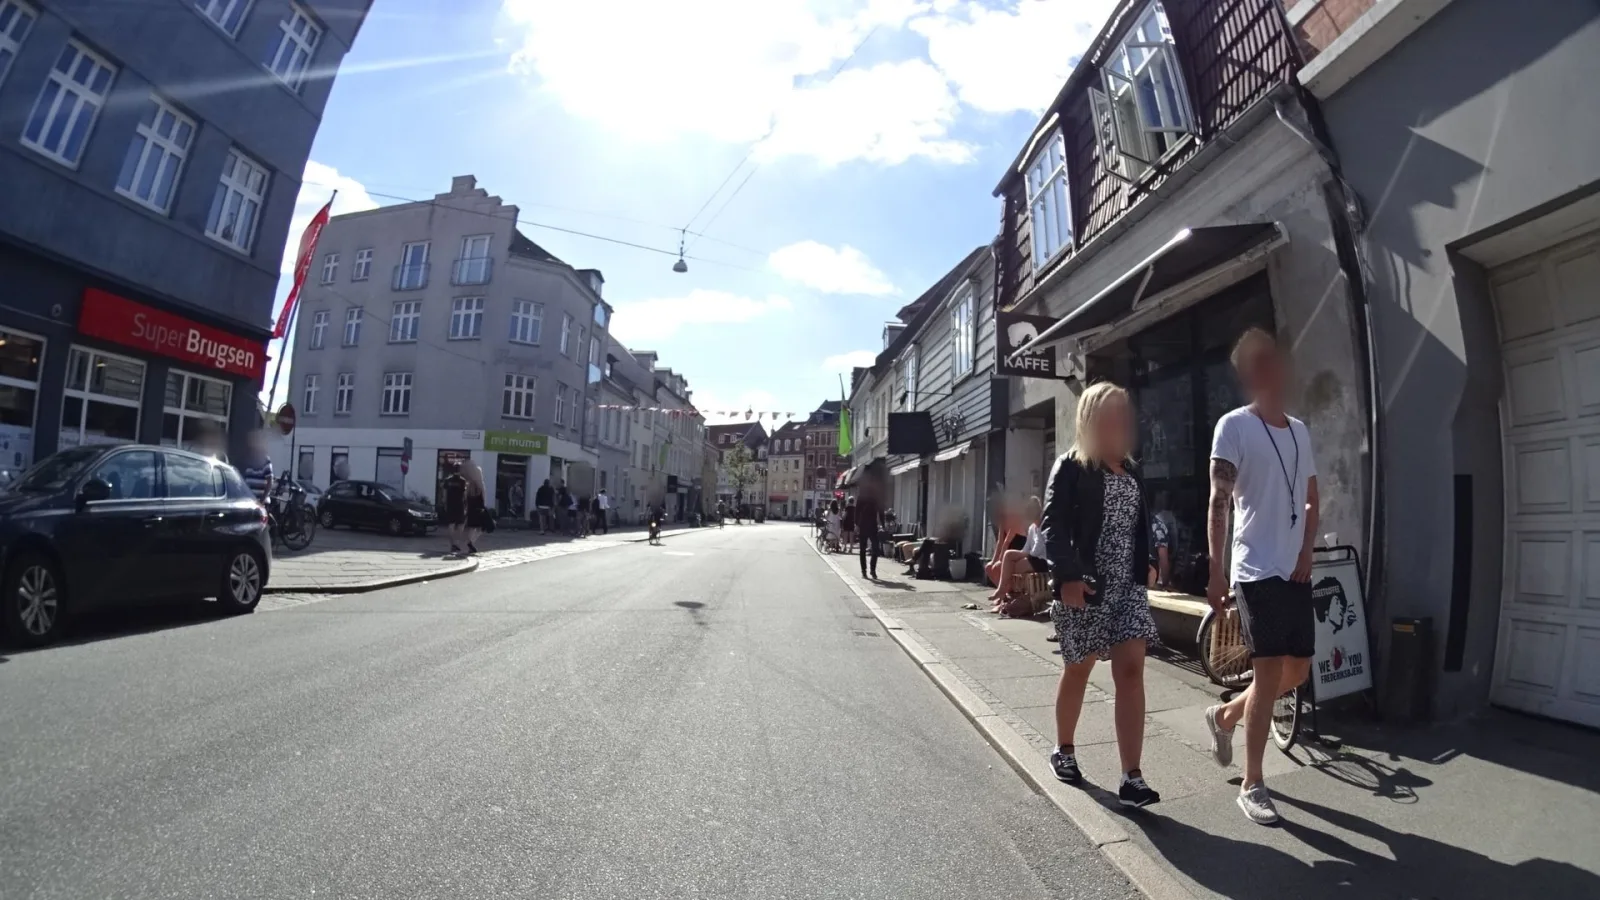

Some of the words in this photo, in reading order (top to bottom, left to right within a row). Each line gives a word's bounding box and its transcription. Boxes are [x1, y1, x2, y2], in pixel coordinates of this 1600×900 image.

[1003, 354, 1050, 372] KAFFE
[508, 438, 541, 449] mums
[1318, 660, 1332, 674] WE
[1348, 652, 1363, 667] YOU
